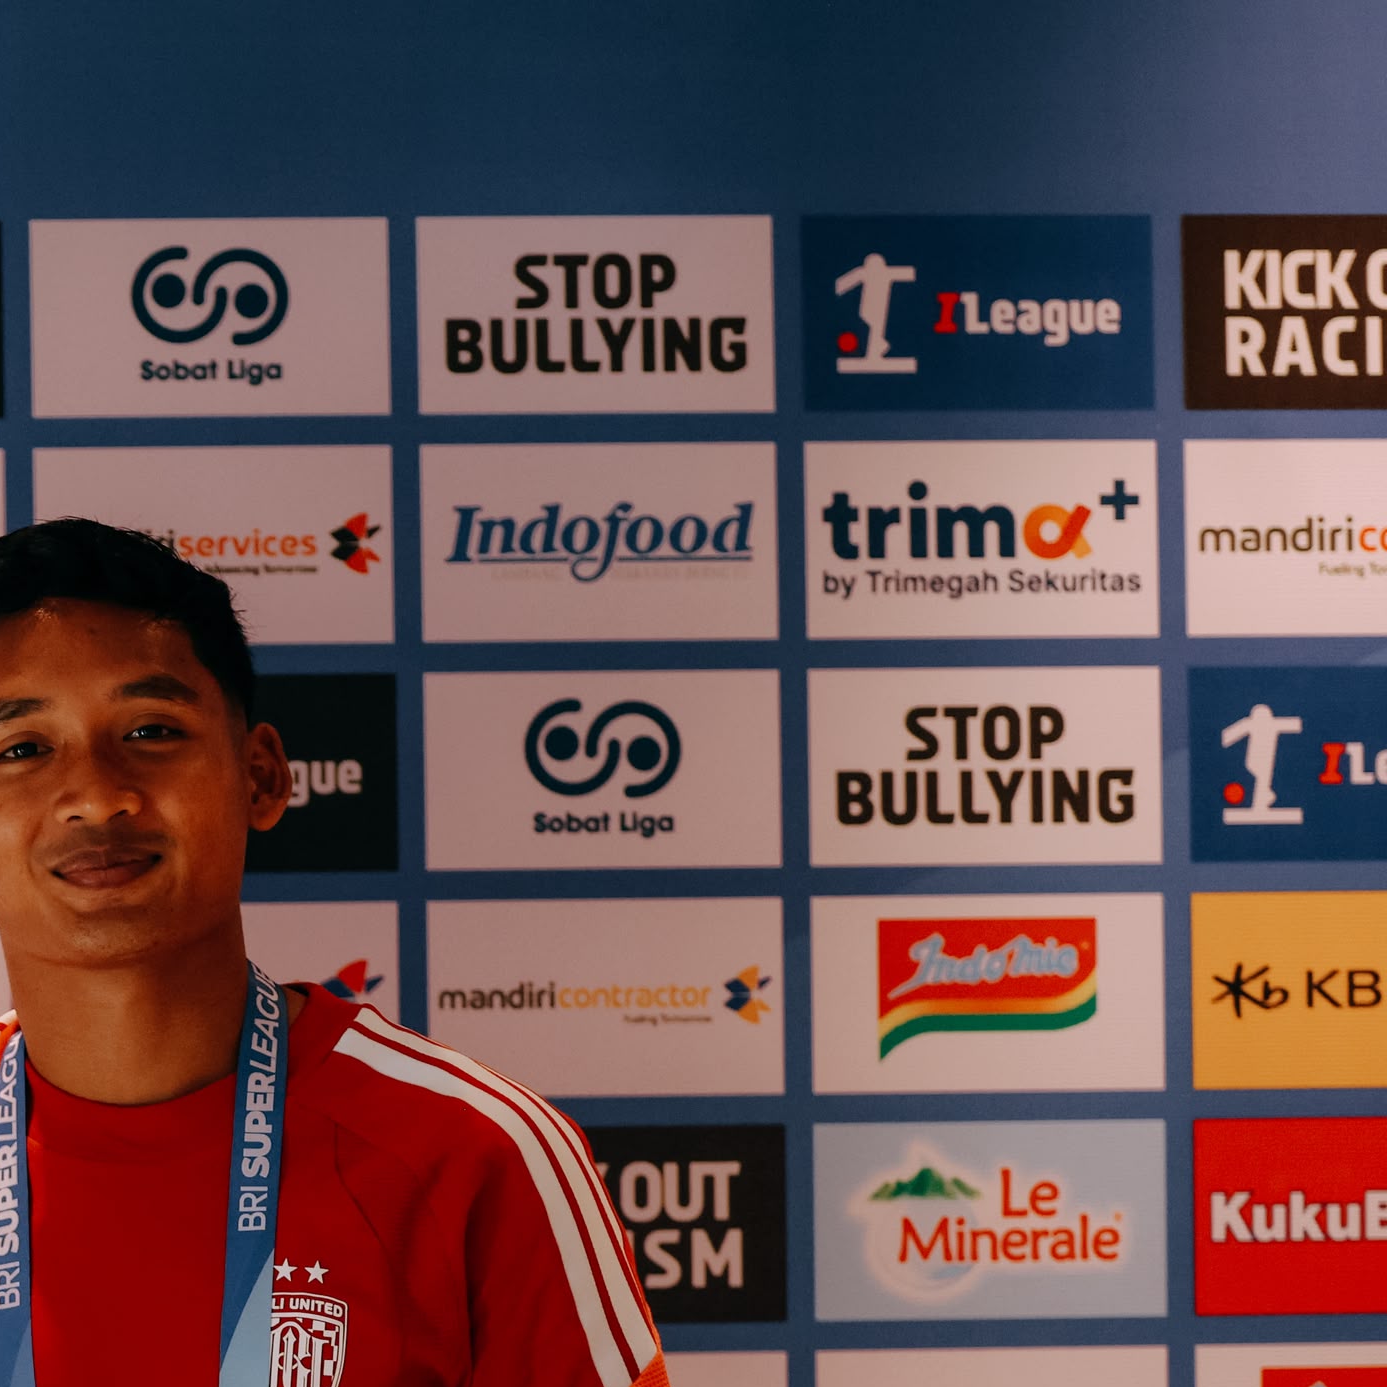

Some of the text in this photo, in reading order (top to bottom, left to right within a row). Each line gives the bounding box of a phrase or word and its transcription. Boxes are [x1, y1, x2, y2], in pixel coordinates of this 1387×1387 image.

[513, 252, 678, 310] STOP
[1224, 249, 1360, 309] KICK
[141, 358, 283, 386] Sobat Liga
[443, 316, 749, 375] BULLYING
[1225, 315, 1384, 376] RACI
[445, 500, 754, 583] Indofood
[1198, 514, 1387, 552] mandirico
[822, 567, 1141, 599] by Trimegah Sekuritas
[903, 705, 1065, 762] STOP
[532, 811, 675, 838] Sobat Liga
[835, 768, 1136, 828] BULLYING
[438, 981, 711, 1012] mandiricontractor
[1305, 968, 1381, 1008] KB
[237, 1185, 269, 1232] BRI
[618, 1161, 742, 1224] OUT
[1000, 1168, 1060, 1219] Le
[1209, 1190, 1387, 1244] KukuB
[898, 1212, 1121, 1266] Minerale
[289, 1297, 343, 1318] UNITED
